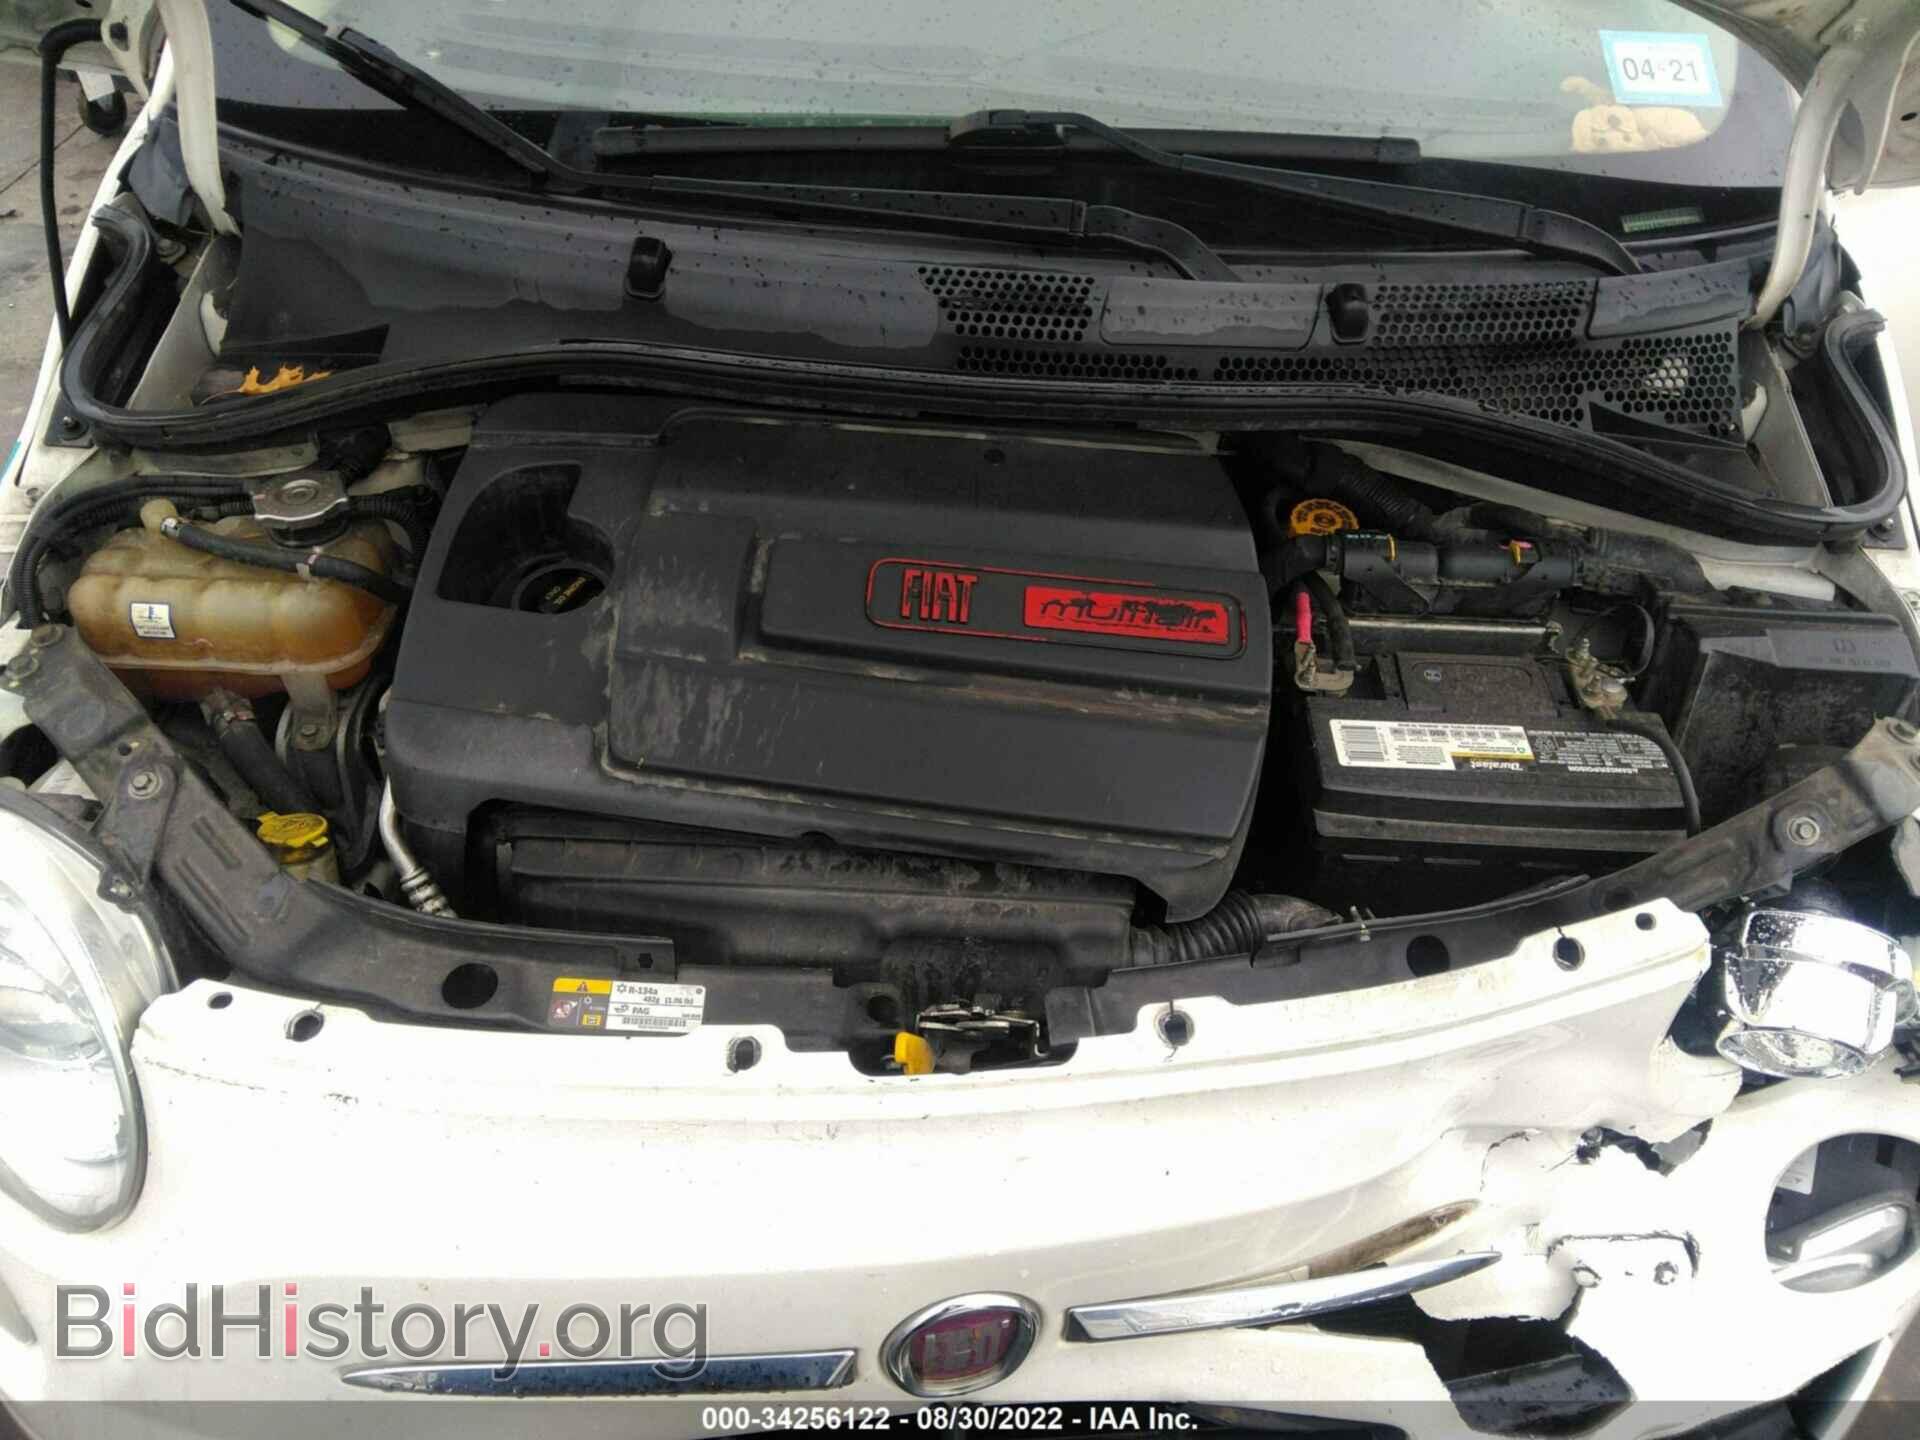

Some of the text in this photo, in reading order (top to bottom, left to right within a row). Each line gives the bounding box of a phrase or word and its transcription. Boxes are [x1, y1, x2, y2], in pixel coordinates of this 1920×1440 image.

[1622, 57, 1698, 81] 04 21
[901, 567, 978, 624] FIAT
[1469, 758, 1524, 772] Duralast
[628, 985, 658, 995] R-134a
[632, 1006, 650, 1015] PAG
